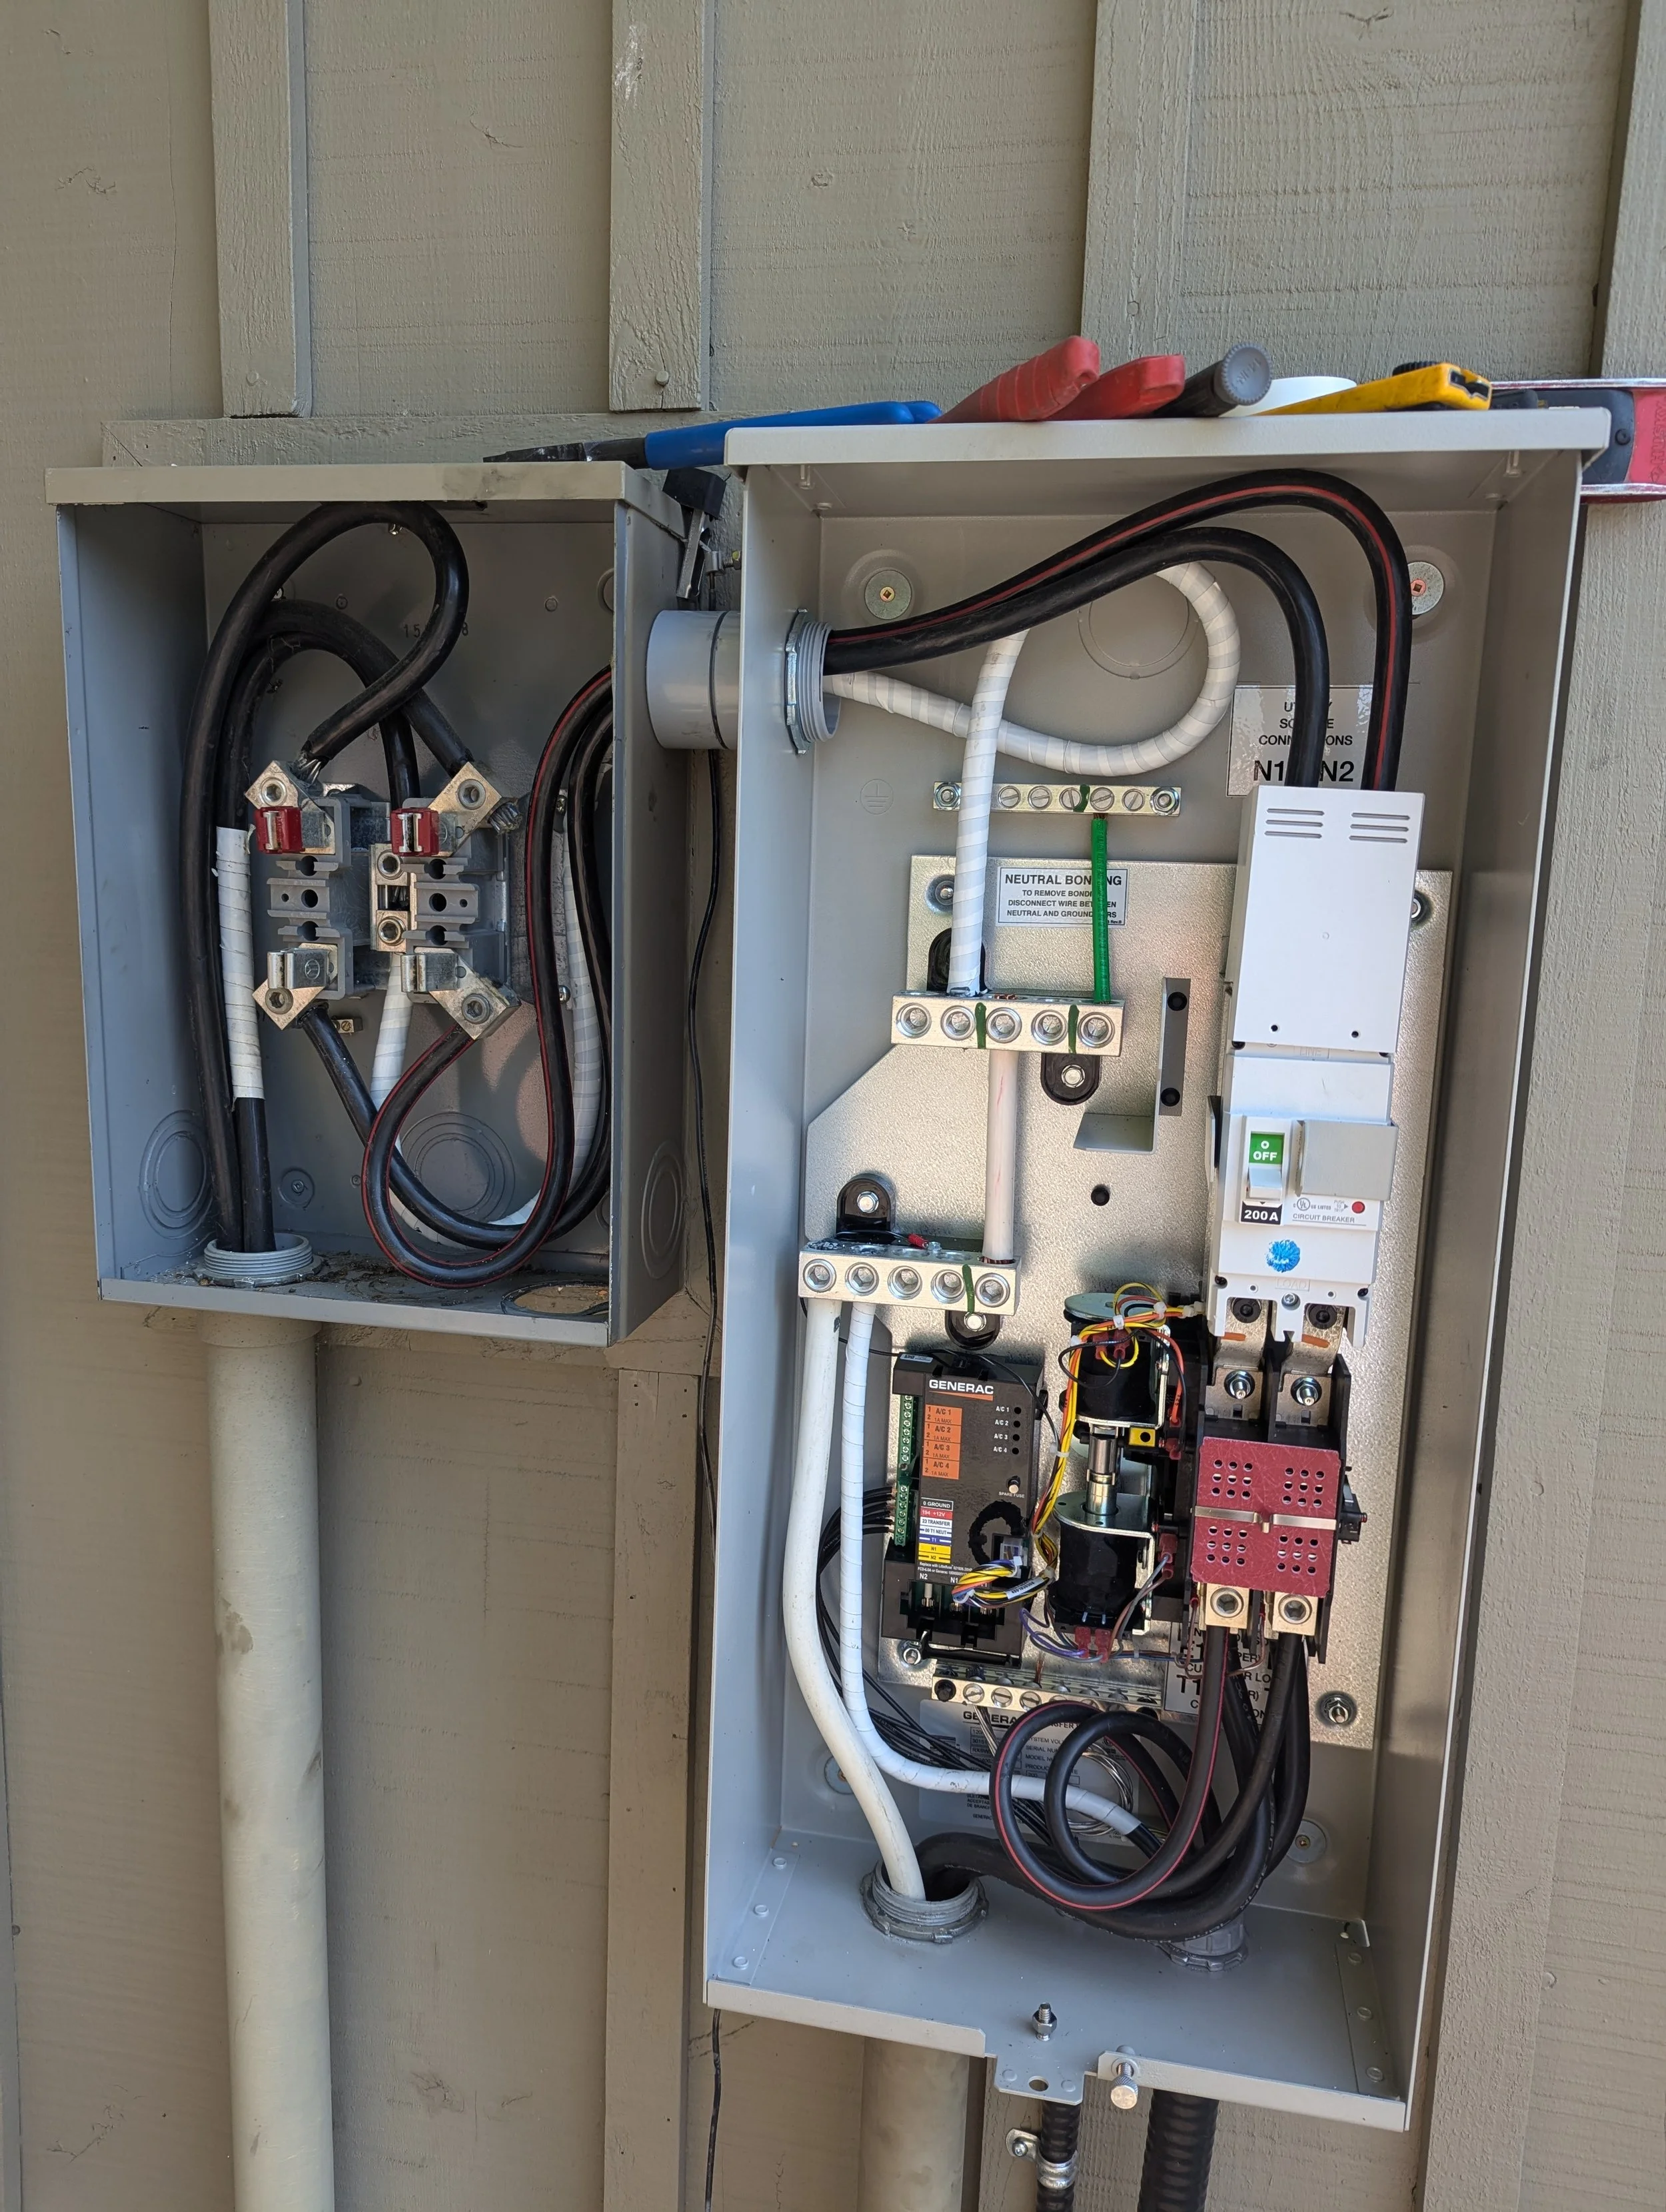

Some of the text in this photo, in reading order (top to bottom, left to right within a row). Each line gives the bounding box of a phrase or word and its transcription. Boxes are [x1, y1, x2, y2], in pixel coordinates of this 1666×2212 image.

[1253, 760, 1354, 782] N1 N2
[1005, 874, 1122, 885] NEUTRAL BONNG
[1253, 1151, 1277, 1161] OFF
[929, 1379, 994, 1394] GENERAC
